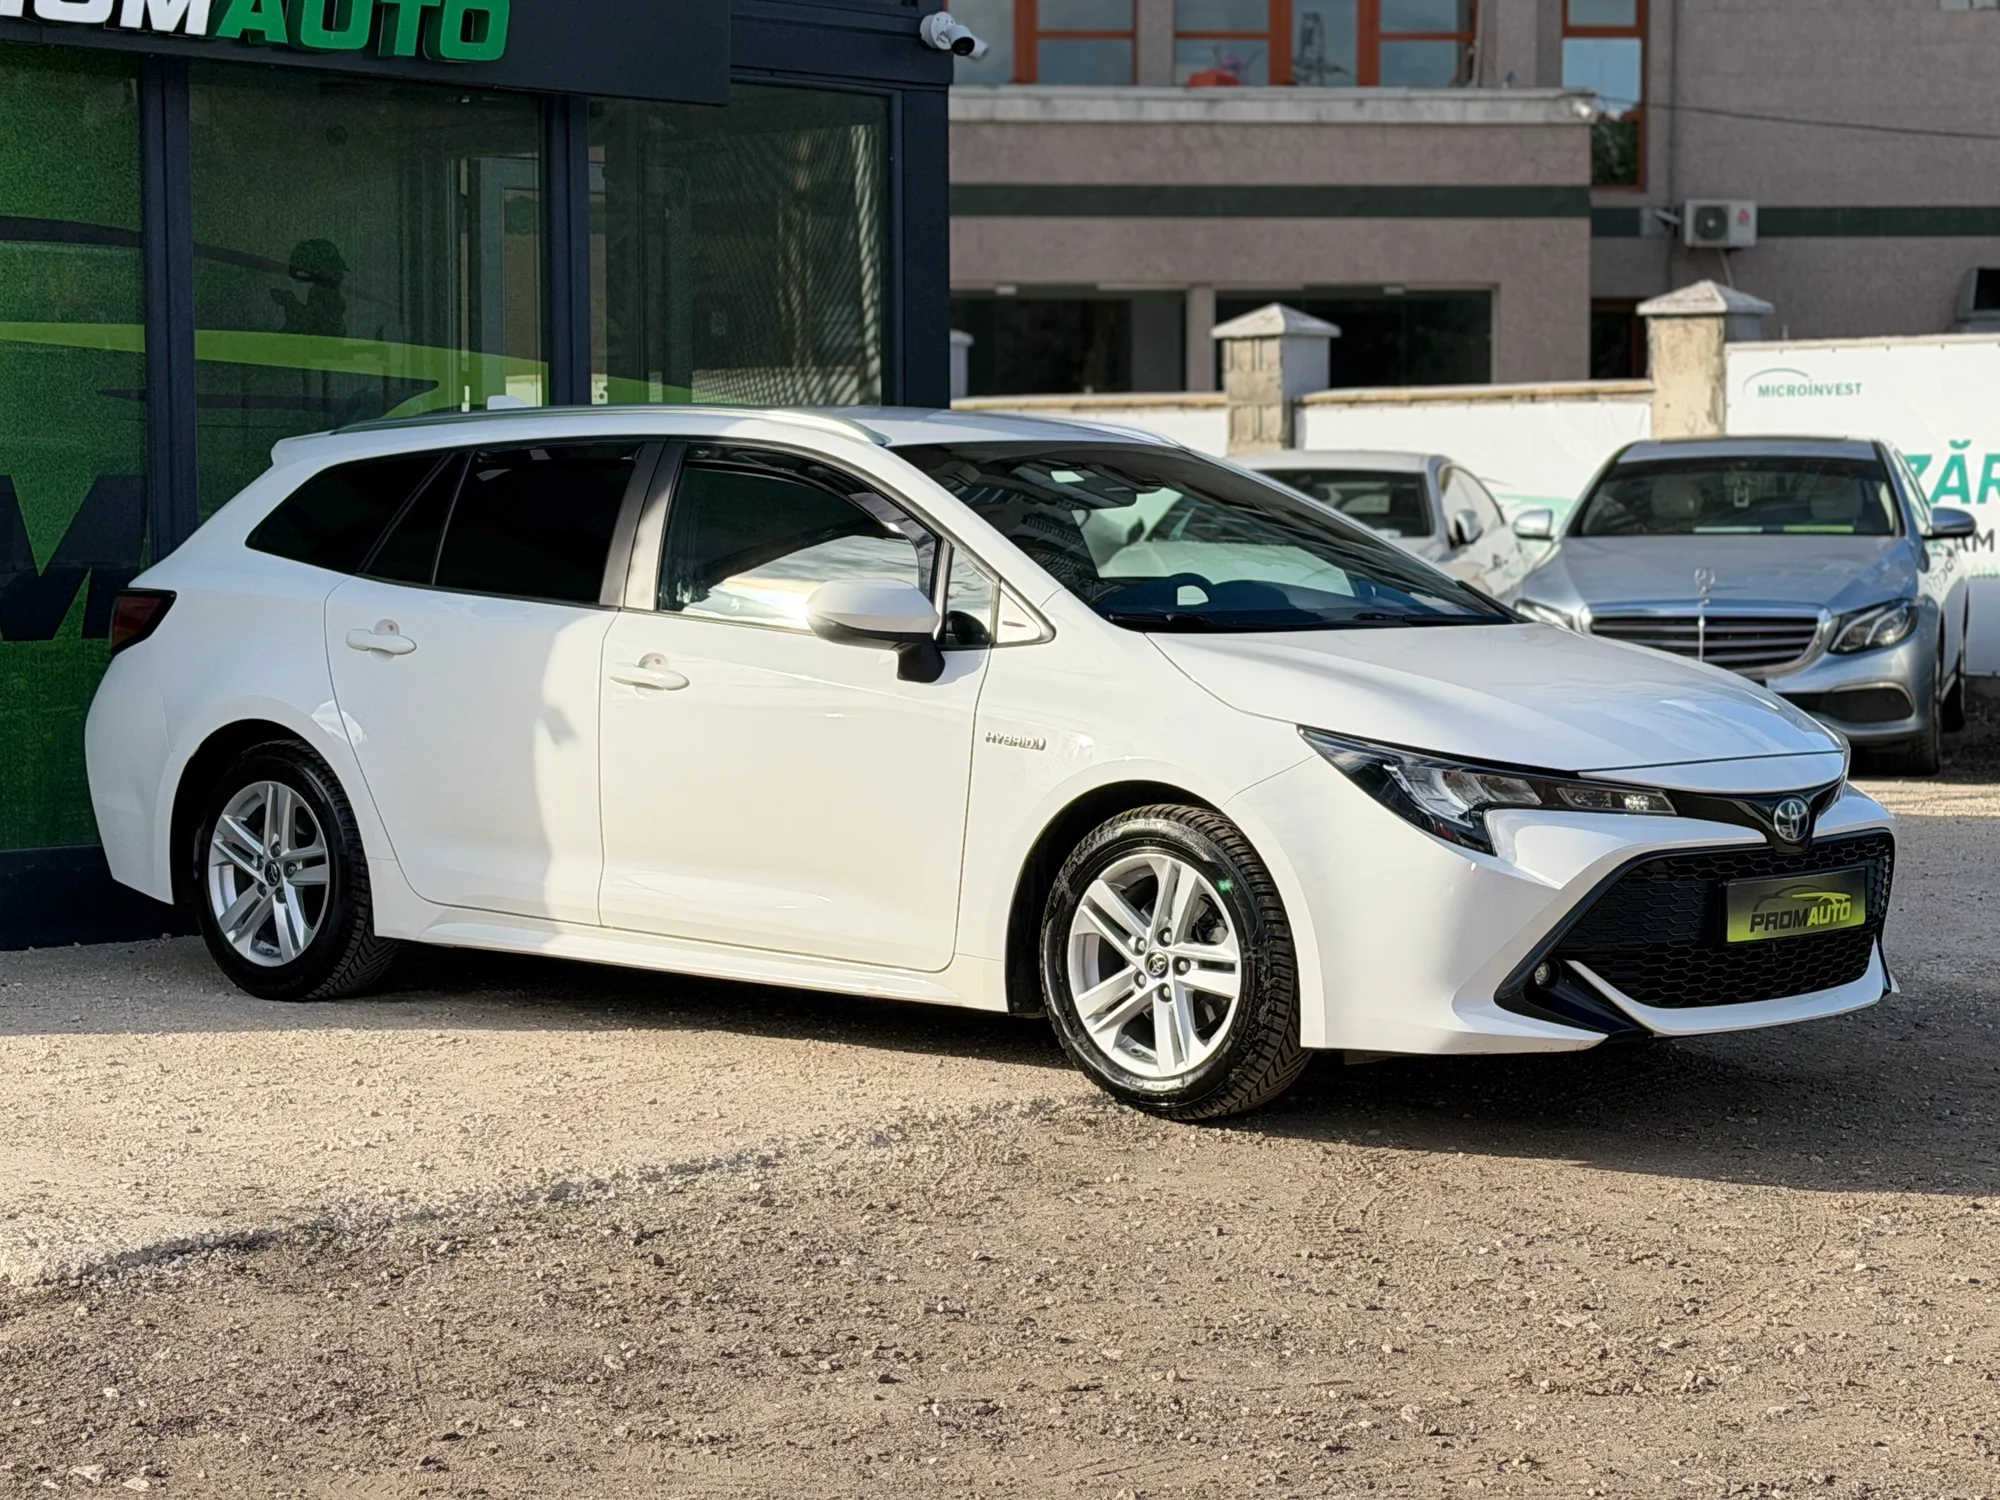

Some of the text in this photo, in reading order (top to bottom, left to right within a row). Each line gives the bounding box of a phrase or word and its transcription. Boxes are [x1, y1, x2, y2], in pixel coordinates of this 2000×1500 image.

[1758, 381, 1862, 397] MICROINVEST
[985, 731, 1036, 749] HYBRID
[1750, 902, 1851, 933] PROMAUTO
